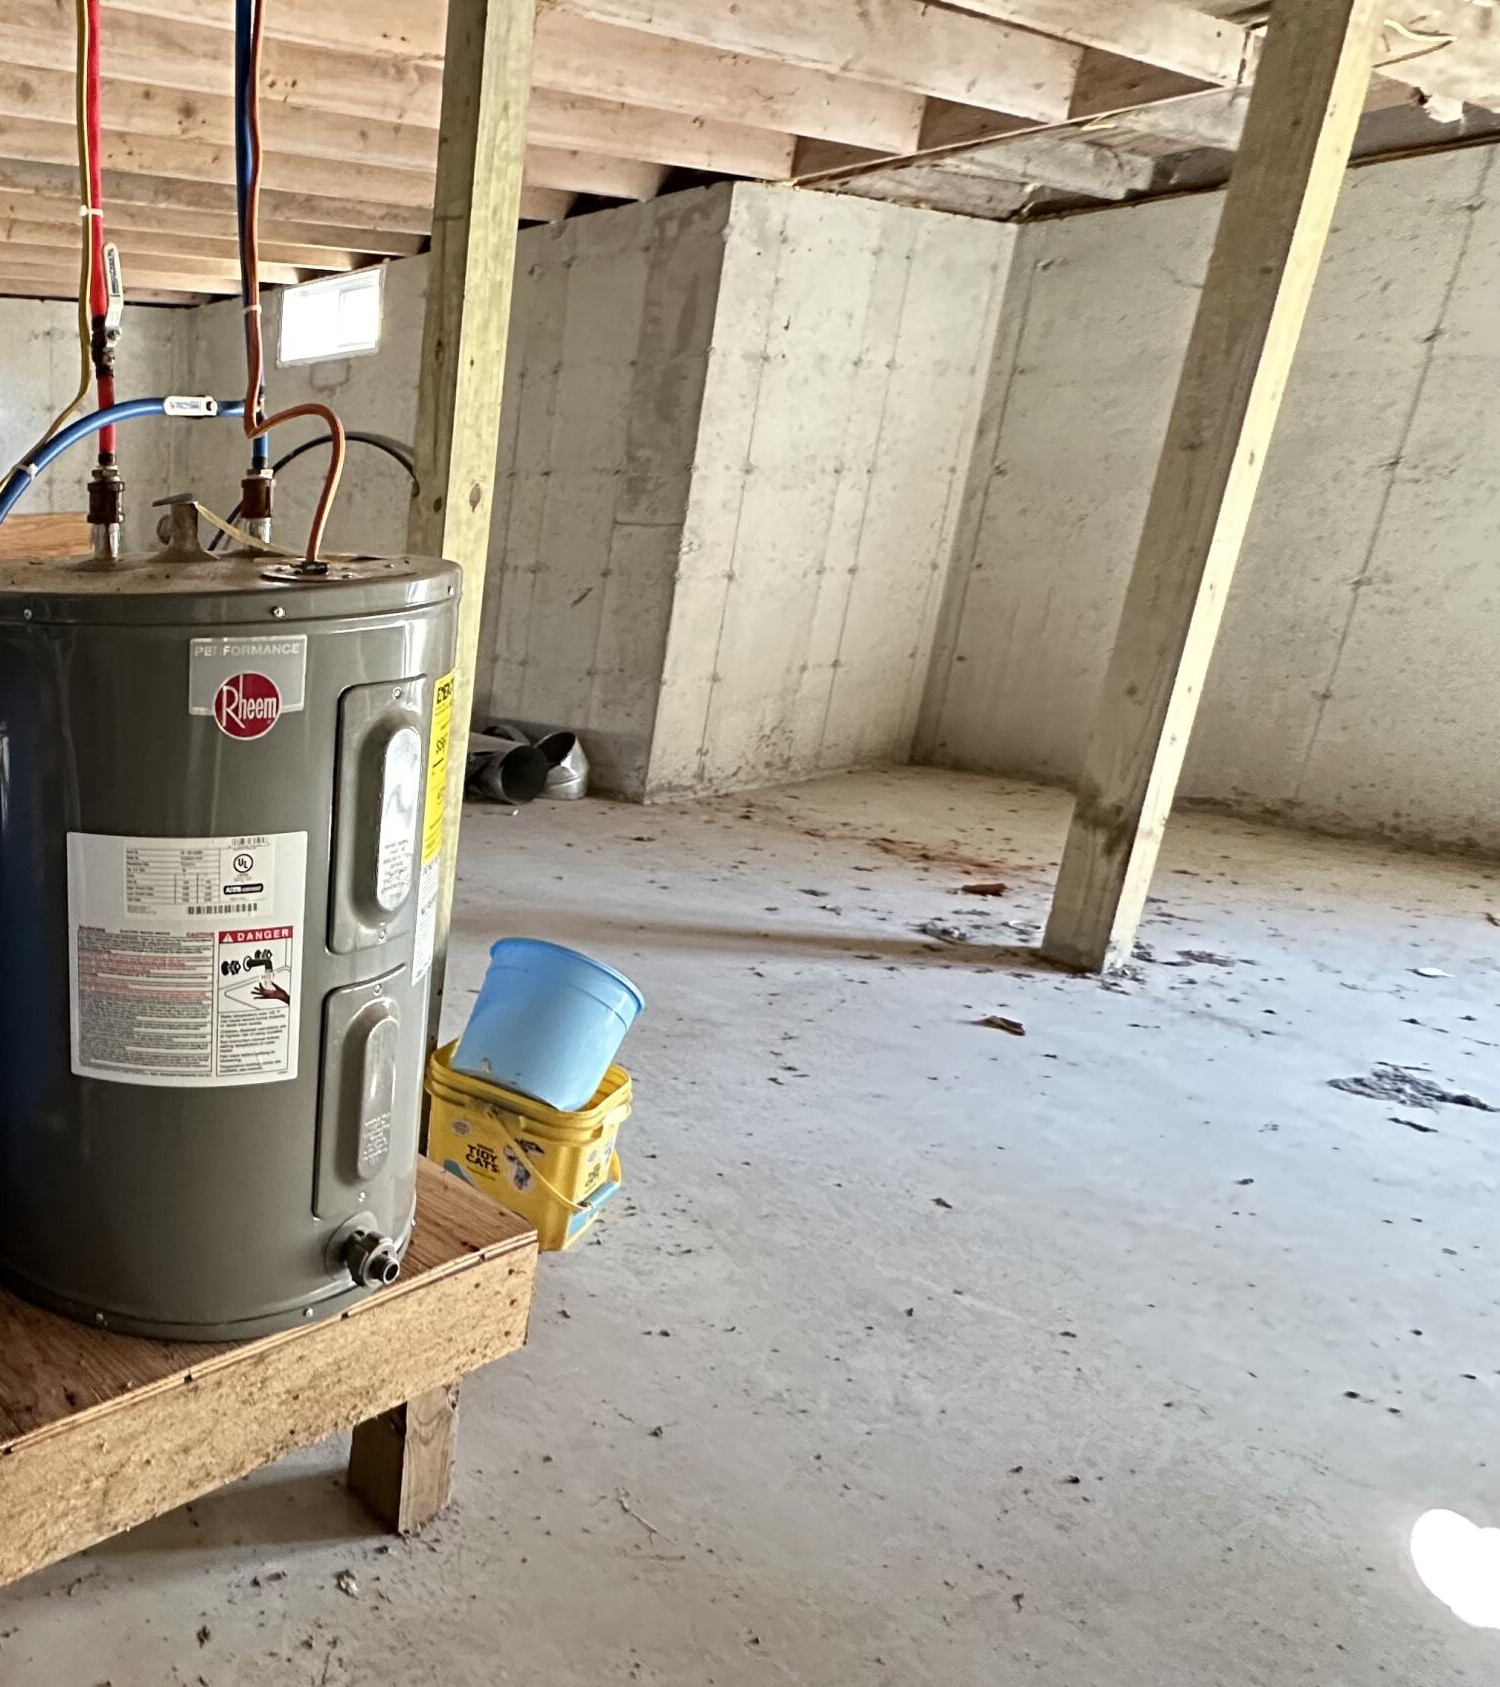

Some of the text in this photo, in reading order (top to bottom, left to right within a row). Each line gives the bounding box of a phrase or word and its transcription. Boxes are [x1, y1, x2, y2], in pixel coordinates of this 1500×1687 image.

[222, 675, 277, 729] Rheem
[237, 928, 289, 942] DANGER
[465, 1153, 499, 1173] CATS
[467, 1144, 498, 1163] TIDY
